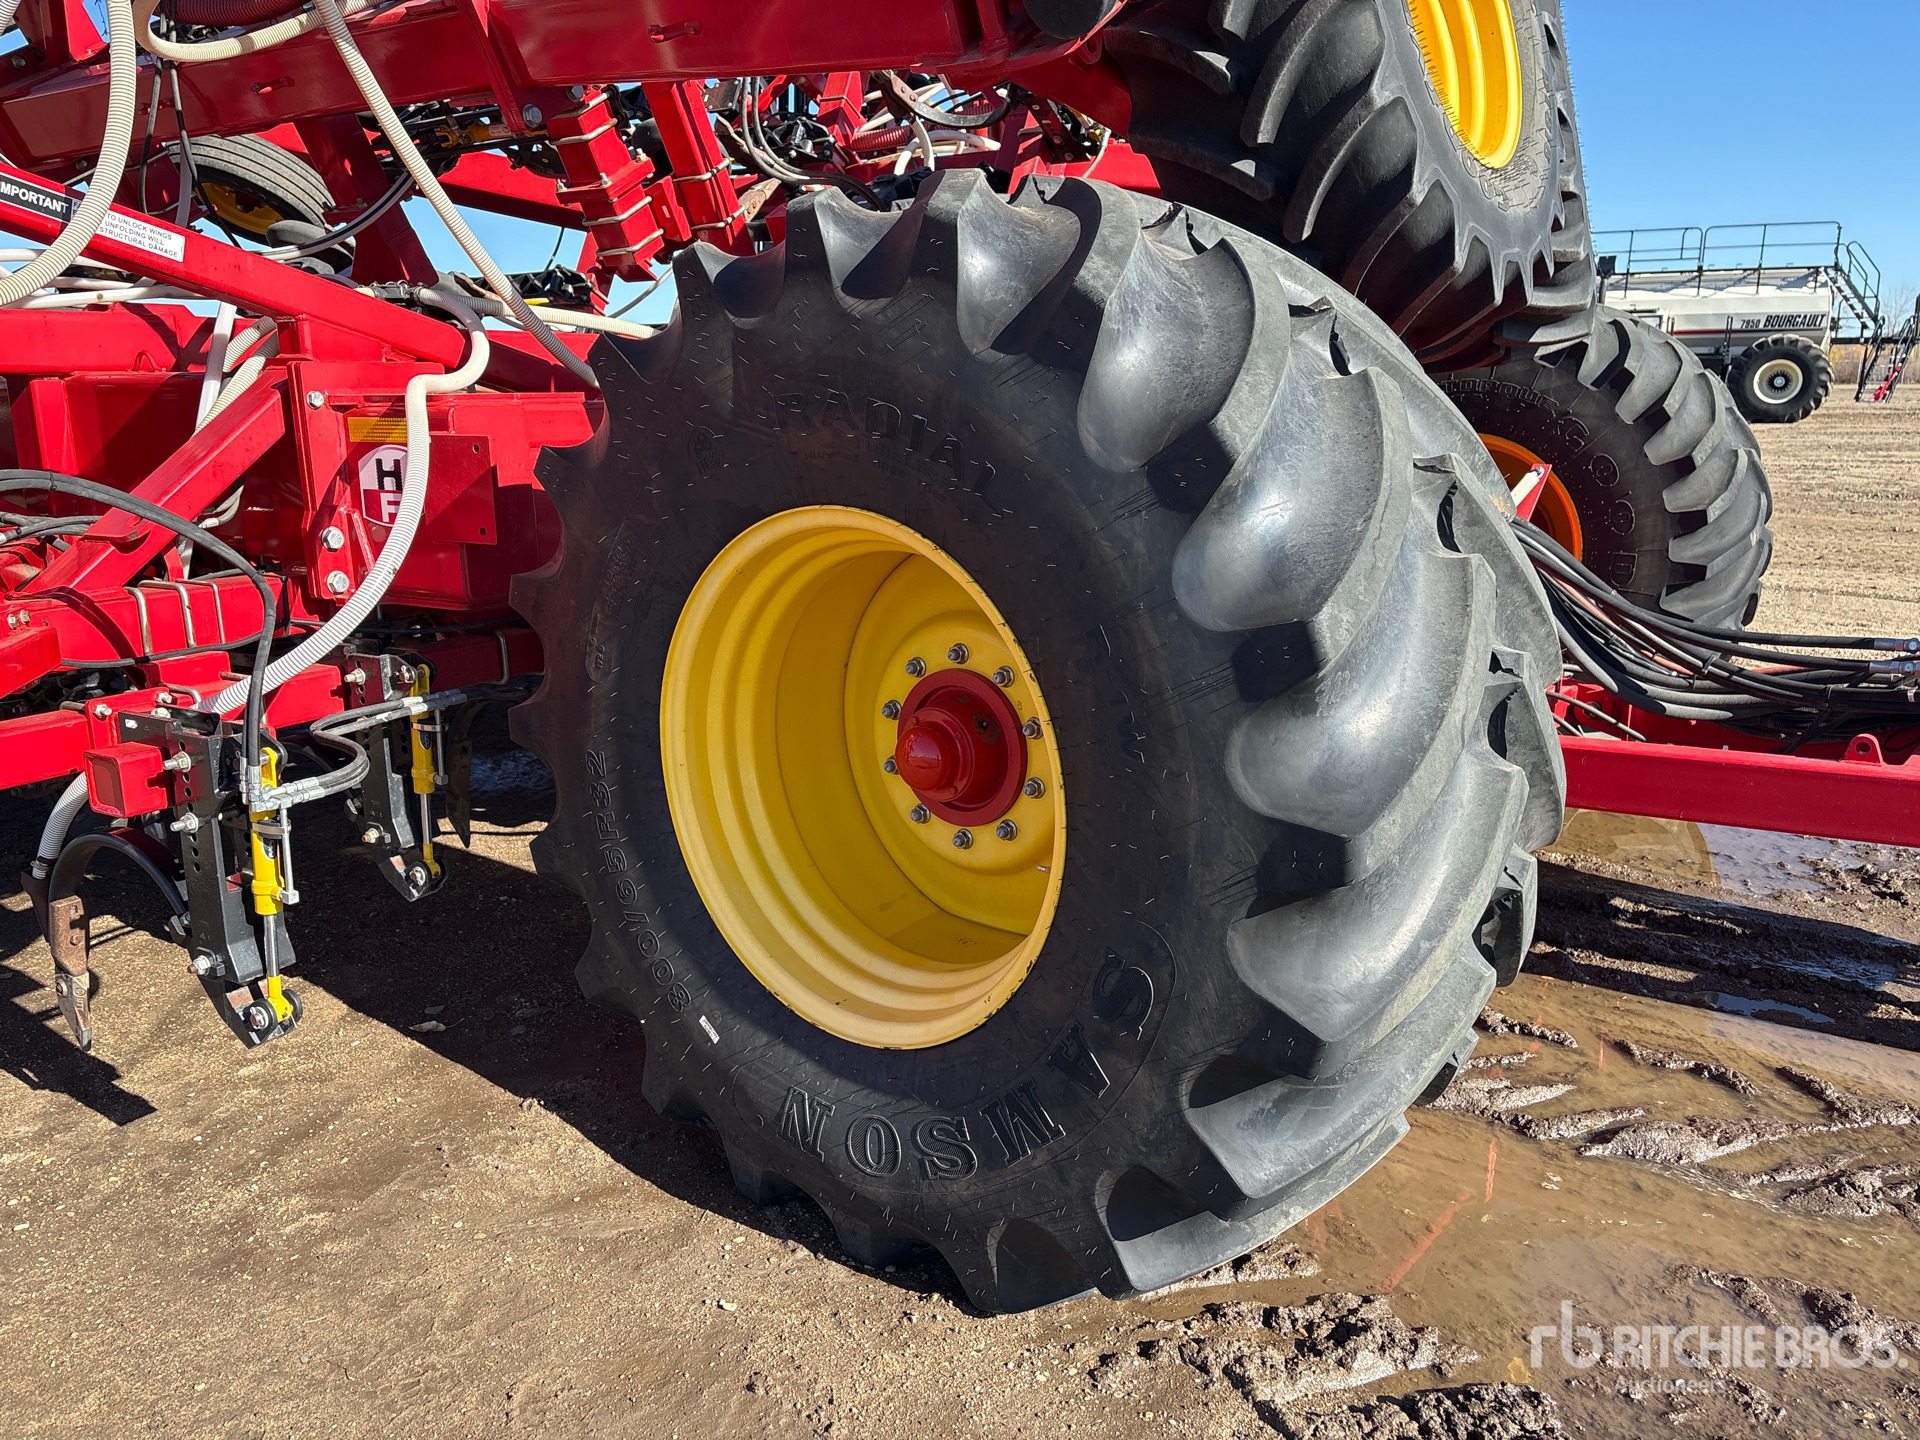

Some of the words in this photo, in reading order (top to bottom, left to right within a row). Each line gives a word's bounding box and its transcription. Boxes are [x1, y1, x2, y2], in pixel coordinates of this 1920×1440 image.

[0, 181, 69, 214] MPORTANT
[99, 226, 147, 248] STRUCTURAL
[148, 243, 178, 258] DAMAGE
[104, 221, 147, 239] UNFOLDING
[147, 235, 165, 247] WILL
[106, 211, 117, 221] TO
[117, 213, 148, 233] UNLOCK
[149, 227, 172, 241] WINGS
[1740, 319, 1761, 329] 7950
[1764, 314, 1826, 328] BOURGAULT
[771, 388, 1003, 518] RADIAL
[375, 458, 403, 491] H
[585, 749, 692, 1014] 800/65R32
[775, 945, 1156, 1181] SAMSON
